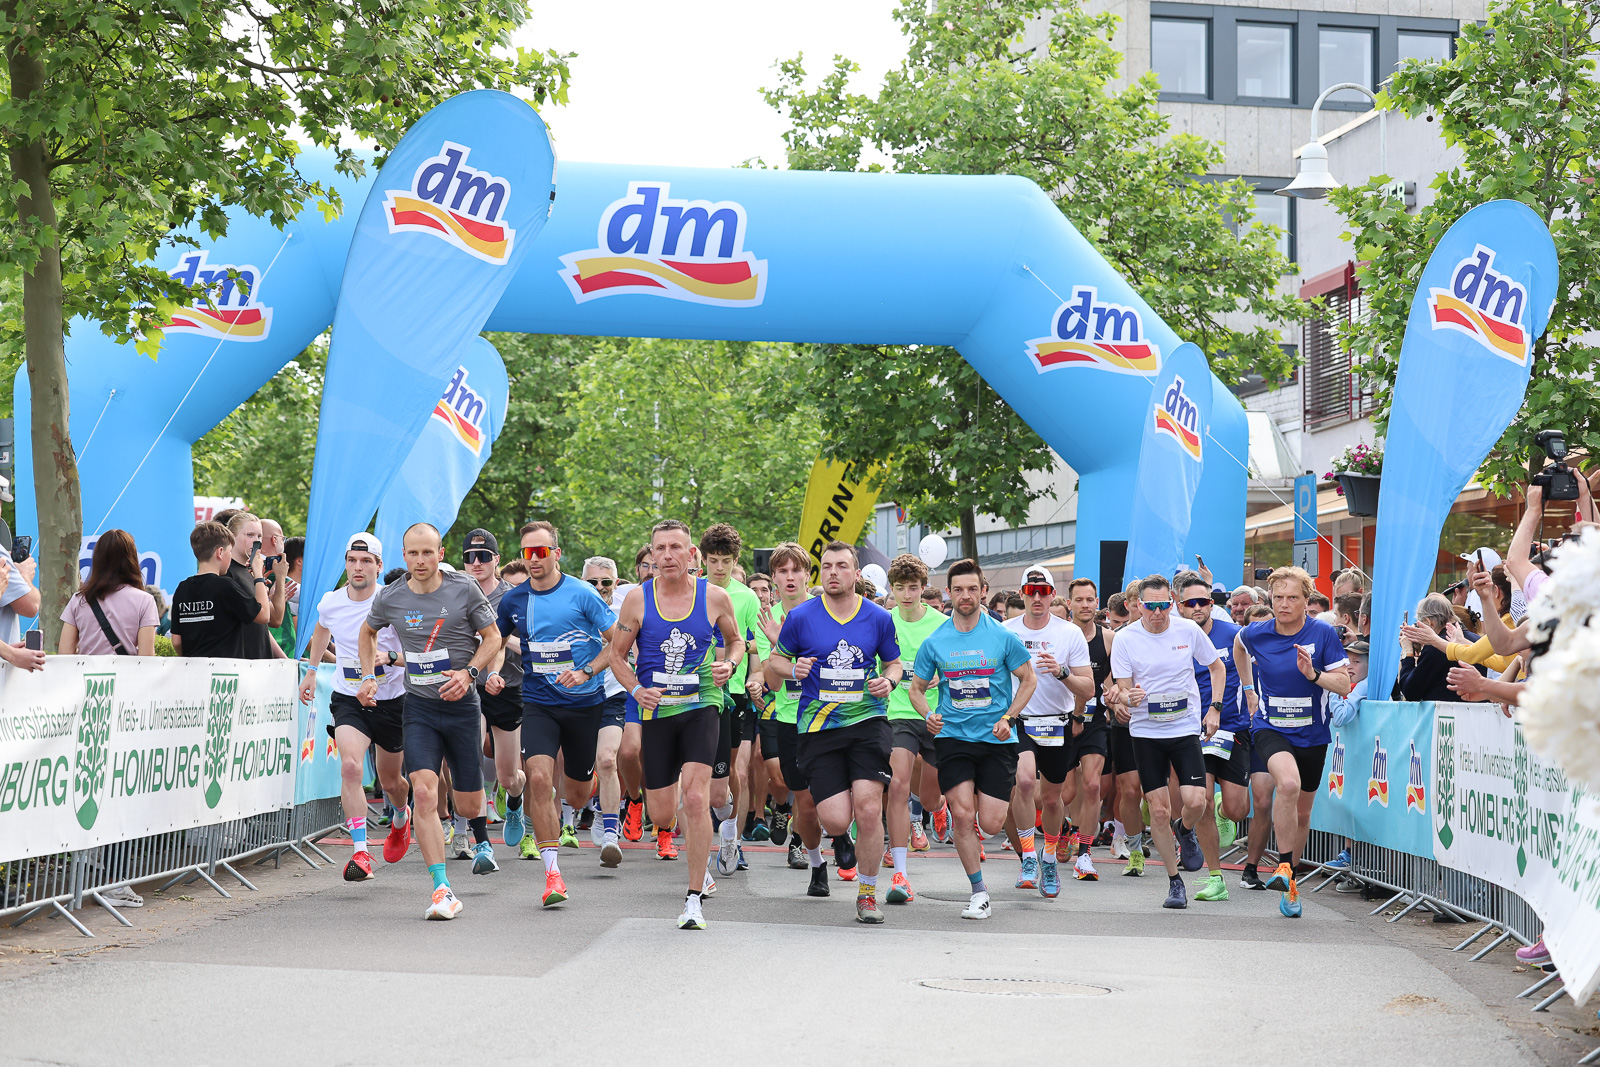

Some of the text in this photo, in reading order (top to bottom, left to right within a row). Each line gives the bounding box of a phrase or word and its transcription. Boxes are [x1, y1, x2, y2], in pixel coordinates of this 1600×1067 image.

[416, 148, 506, 222] dm
[606, 187, 739, 258] dm
[1455, 251, 1524, 324] dm
[1058, 291, 1138, 342] dm
[1165, 379, 1197, 432] dm
[1299, 484, 1312, 533] P
[418, 662, 435, 670] Yves
[831, 680, 854, 688] Jeremy
[116, 702, 138, 732] Kreis-
[111, 744, 201, 798] HOMBURG
[1333, 736, 1344, 773] dm
[1373, 740, 1386, 780] dm
[1410, 744, 1422, 785] dm
[1460, 788, 1515, 846] HOMBURG
